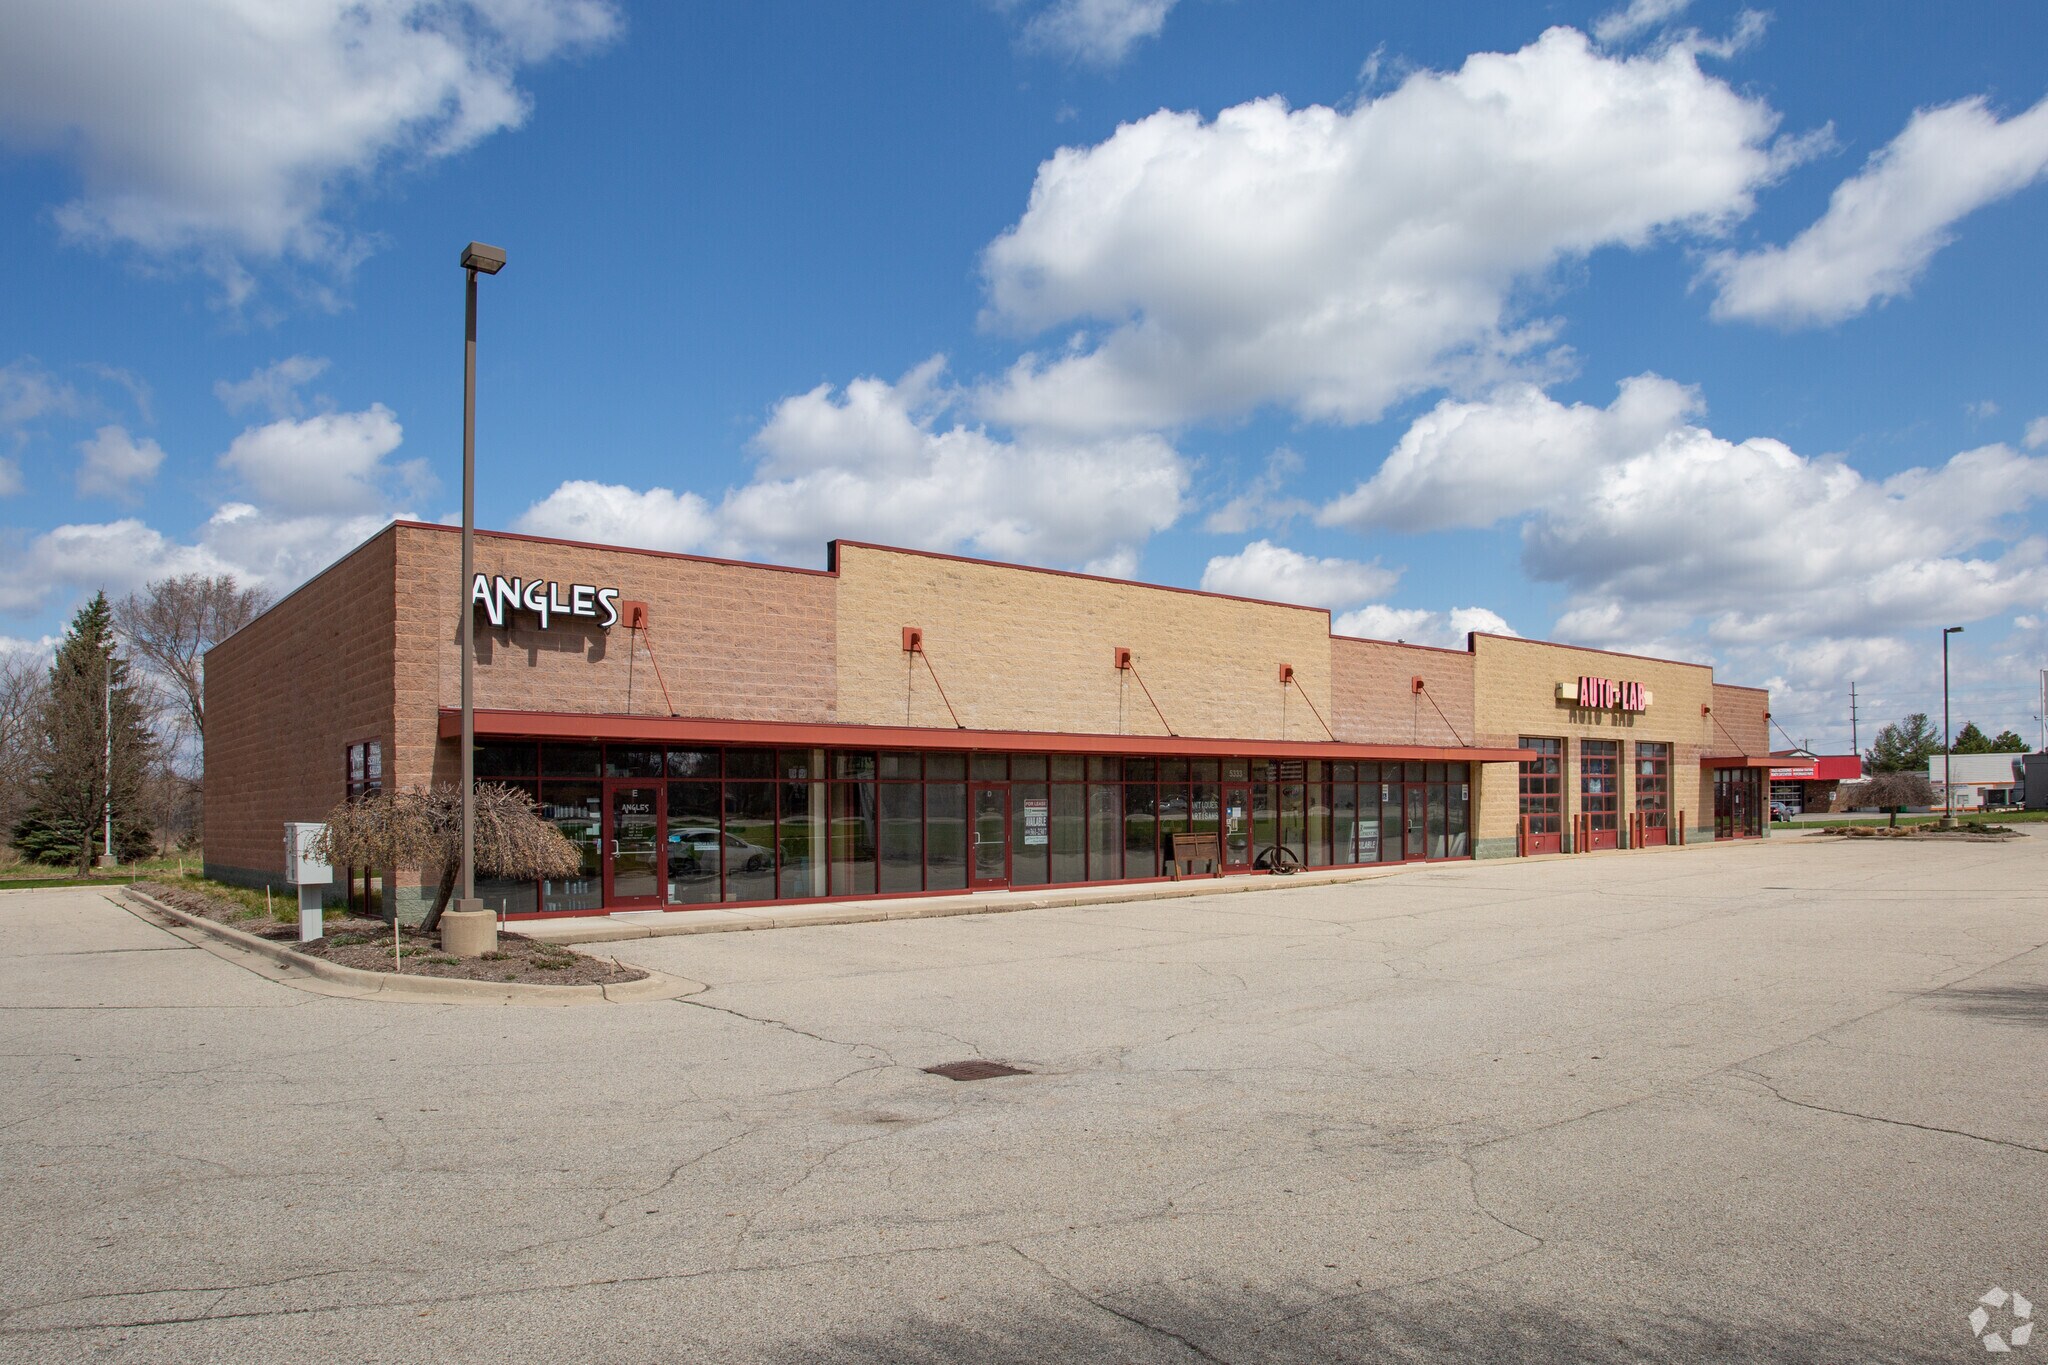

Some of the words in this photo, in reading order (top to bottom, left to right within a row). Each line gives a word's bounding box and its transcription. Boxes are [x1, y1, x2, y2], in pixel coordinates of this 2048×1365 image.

[473, 573, 619, 629] ANGLES
[632, 789, 638, 797] E
[622, 803, 649, 814] ANGLES
[1026, 816, 1046, 827] AVAILABLE
